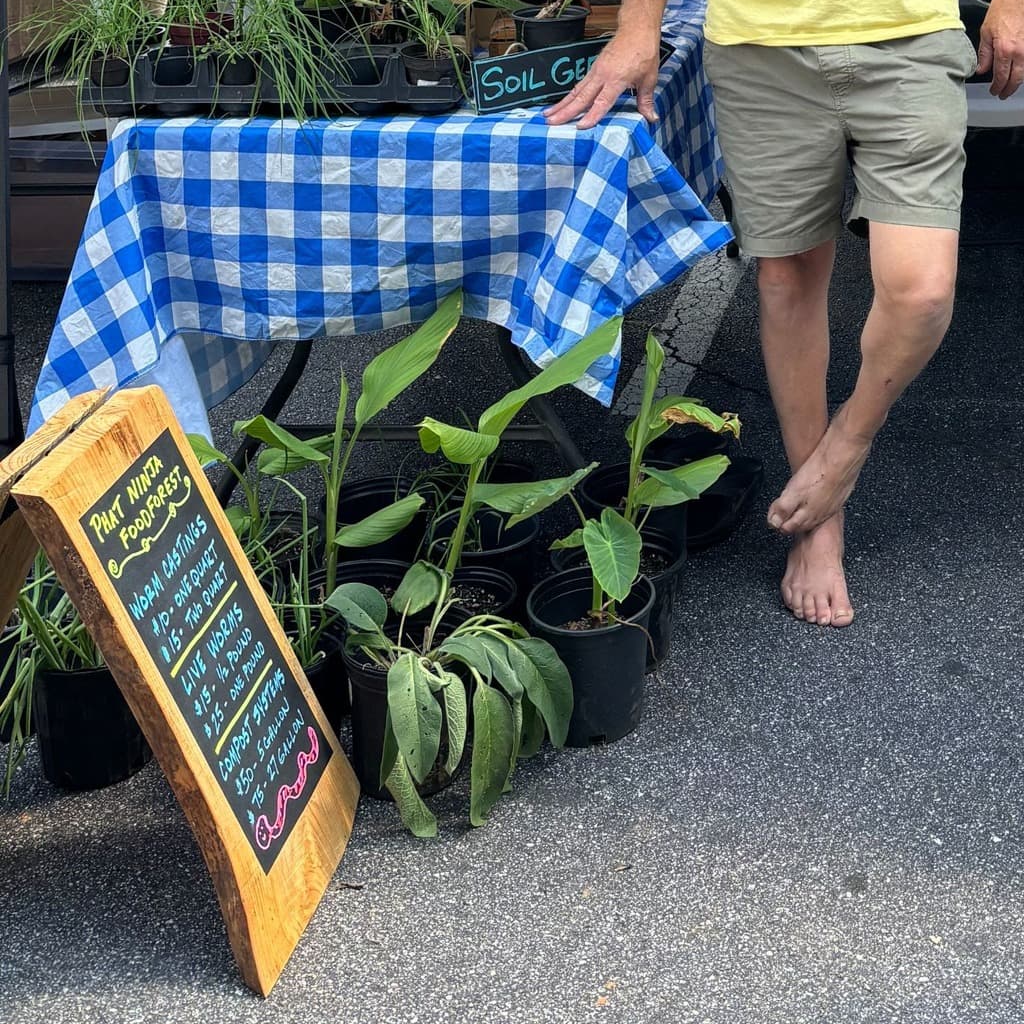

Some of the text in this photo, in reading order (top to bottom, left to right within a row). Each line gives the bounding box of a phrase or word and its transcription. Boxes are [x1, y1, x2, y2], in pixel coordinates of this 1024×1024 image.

[481, 66, 545, 102] SOIL
[89, 455, 164, 543] PHAT NINJA
[119, 465, 182, 549] FOODFOREST
[129, 514, 207, 620] WORM CASTINGS
[174, 574, 192, 607] ONE
[190, 538, 218, 588] QUART
[185, 603, 203, 629] TWO
[202, 561, 228, 607] QUART
[181, 602, 243, 696] LIVE WORMS
[227, 627, 252, 672] POUND
[230, 674, 245, 701] ONE
[242, 641, 265, 682] POUND
[219, 668, 286, 782] COMPOST SYSTEMS
[263, 697, 290, 750] GALLON
[267, 754, 280, 781] 27
[278, 708, 305, 765] GALLON
